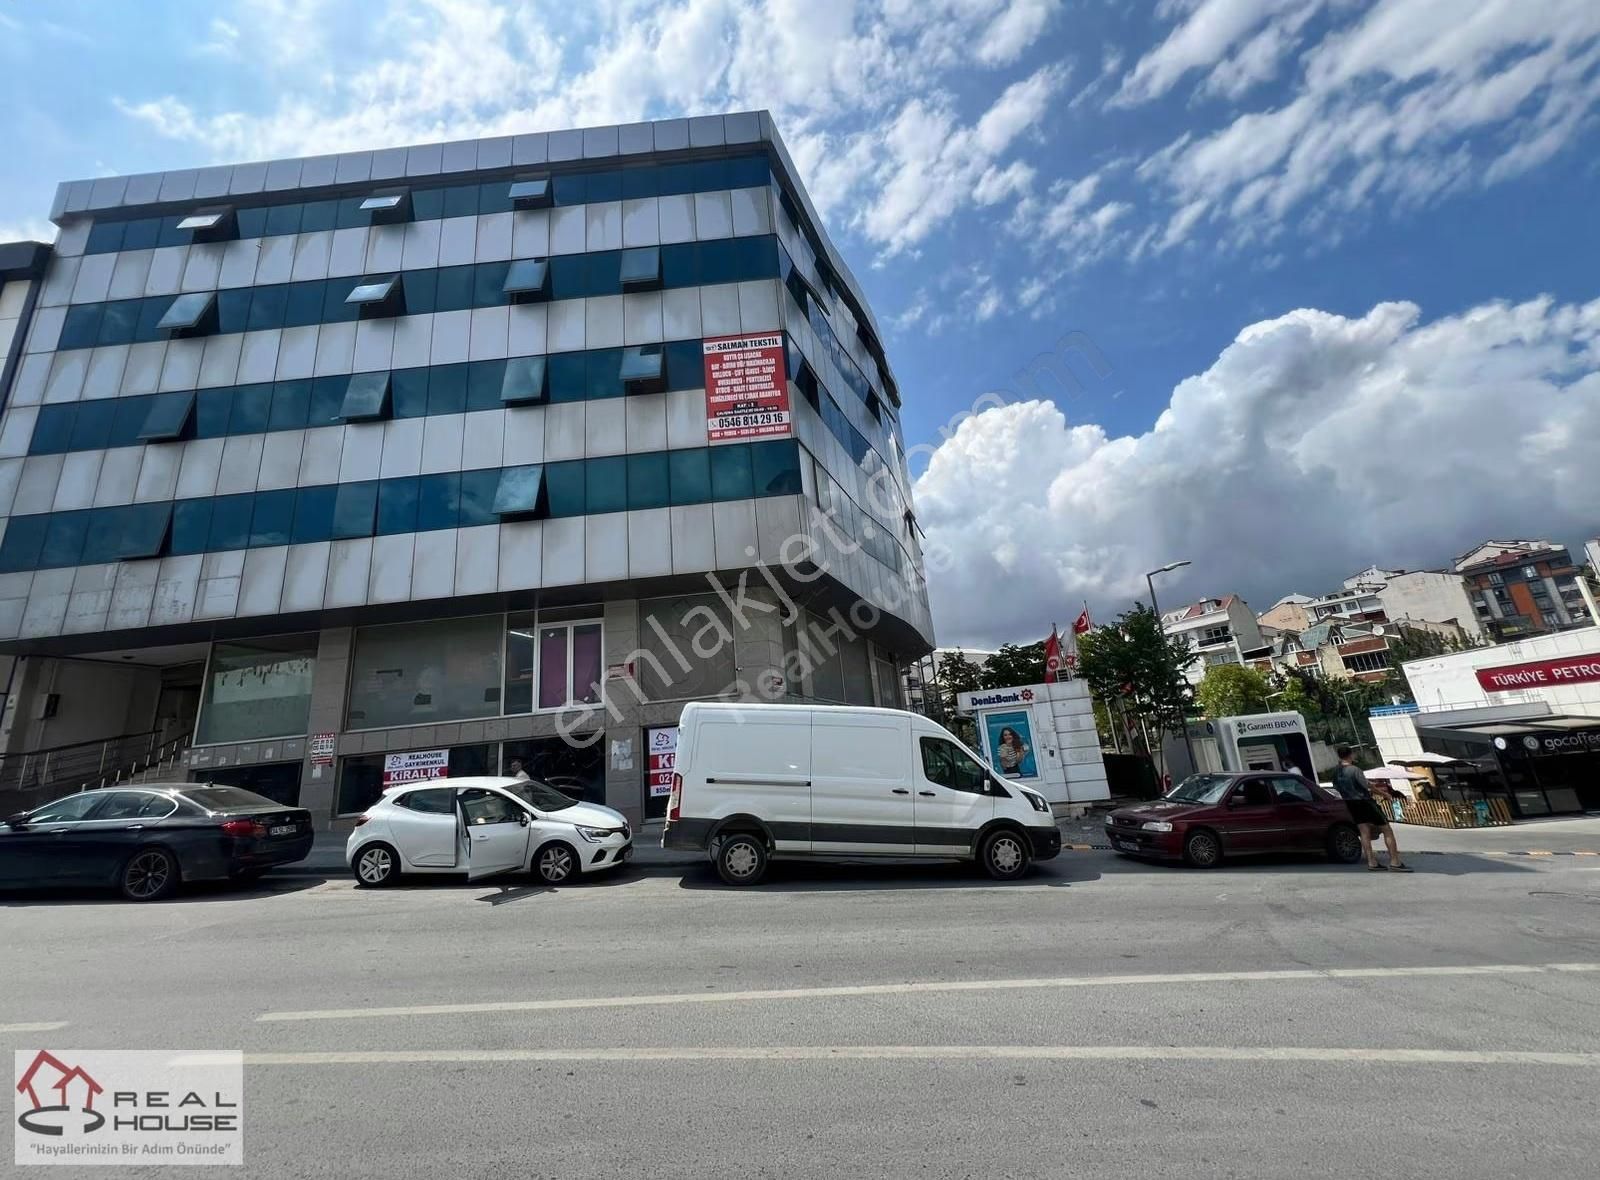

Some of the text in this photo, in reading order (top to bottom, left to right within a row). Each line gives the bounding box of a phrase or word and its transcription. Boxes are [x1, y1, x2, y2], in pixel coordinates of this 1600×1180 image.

[717, 340, 748, 351] SALMAN
[750, 337, 778, 348] TEKSTİL
[718, 412, 783, 428] 0546 814 29 16
[1490, 670, 1548, 686] TÜRKİYE
[970, 692, 1021, 706] DenizBank
[1246, 719, 1298, 731] Garanti BBVA
